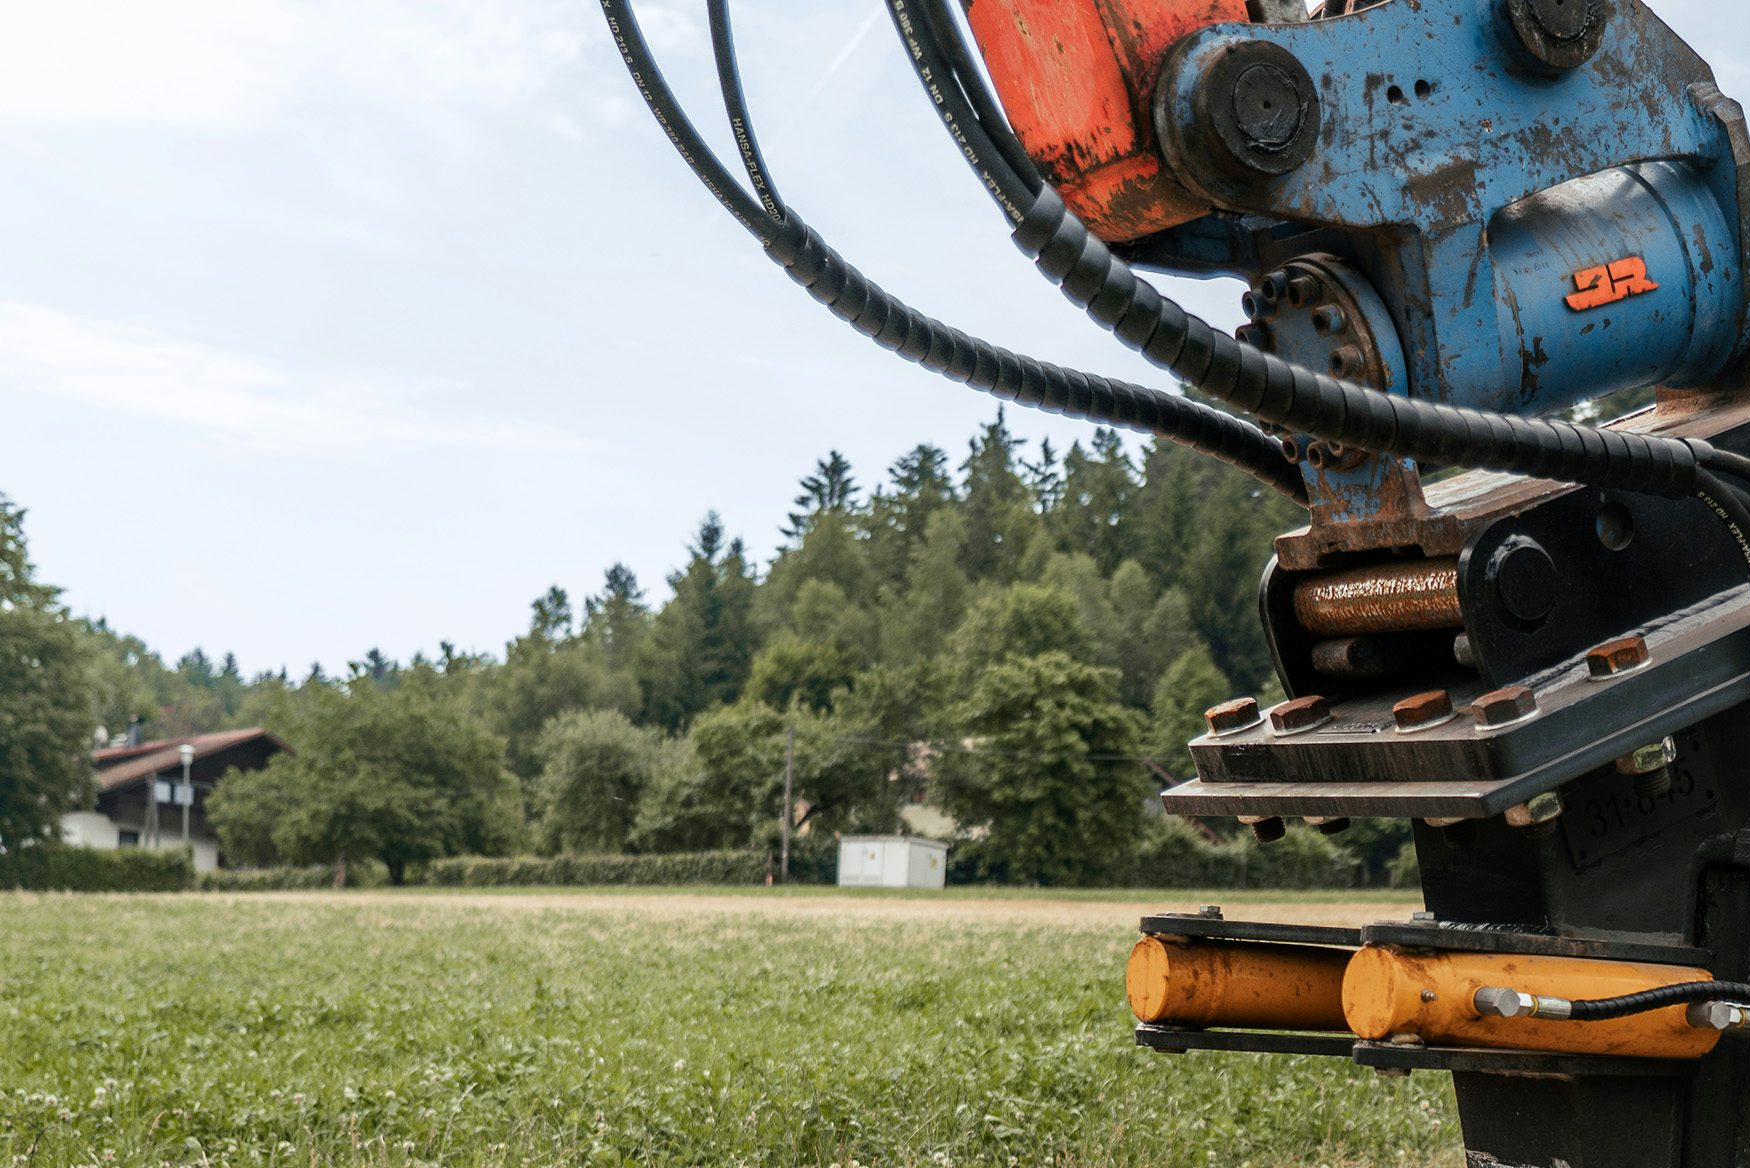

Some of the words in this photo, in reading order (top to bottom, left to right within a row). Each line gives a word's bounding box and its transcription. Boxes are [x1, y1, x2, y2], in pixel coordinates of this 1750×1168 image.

[899, 13, 914, 36] 380
[608, 16, 620, 33] HD
[615, 36, 629, 54] 213
[633, 71, 646, 87] DN
[642, 89, 653, 101] 12
[909, 38, 923, 60] WP
[922, 66, 933, 83] 12
[930, 84, 944, 105] DN
[732, 117, 766, 191] HANSA-FLEX
[964, 146, 980, 165] HD
[1715, 507, 1729, 520] HD
